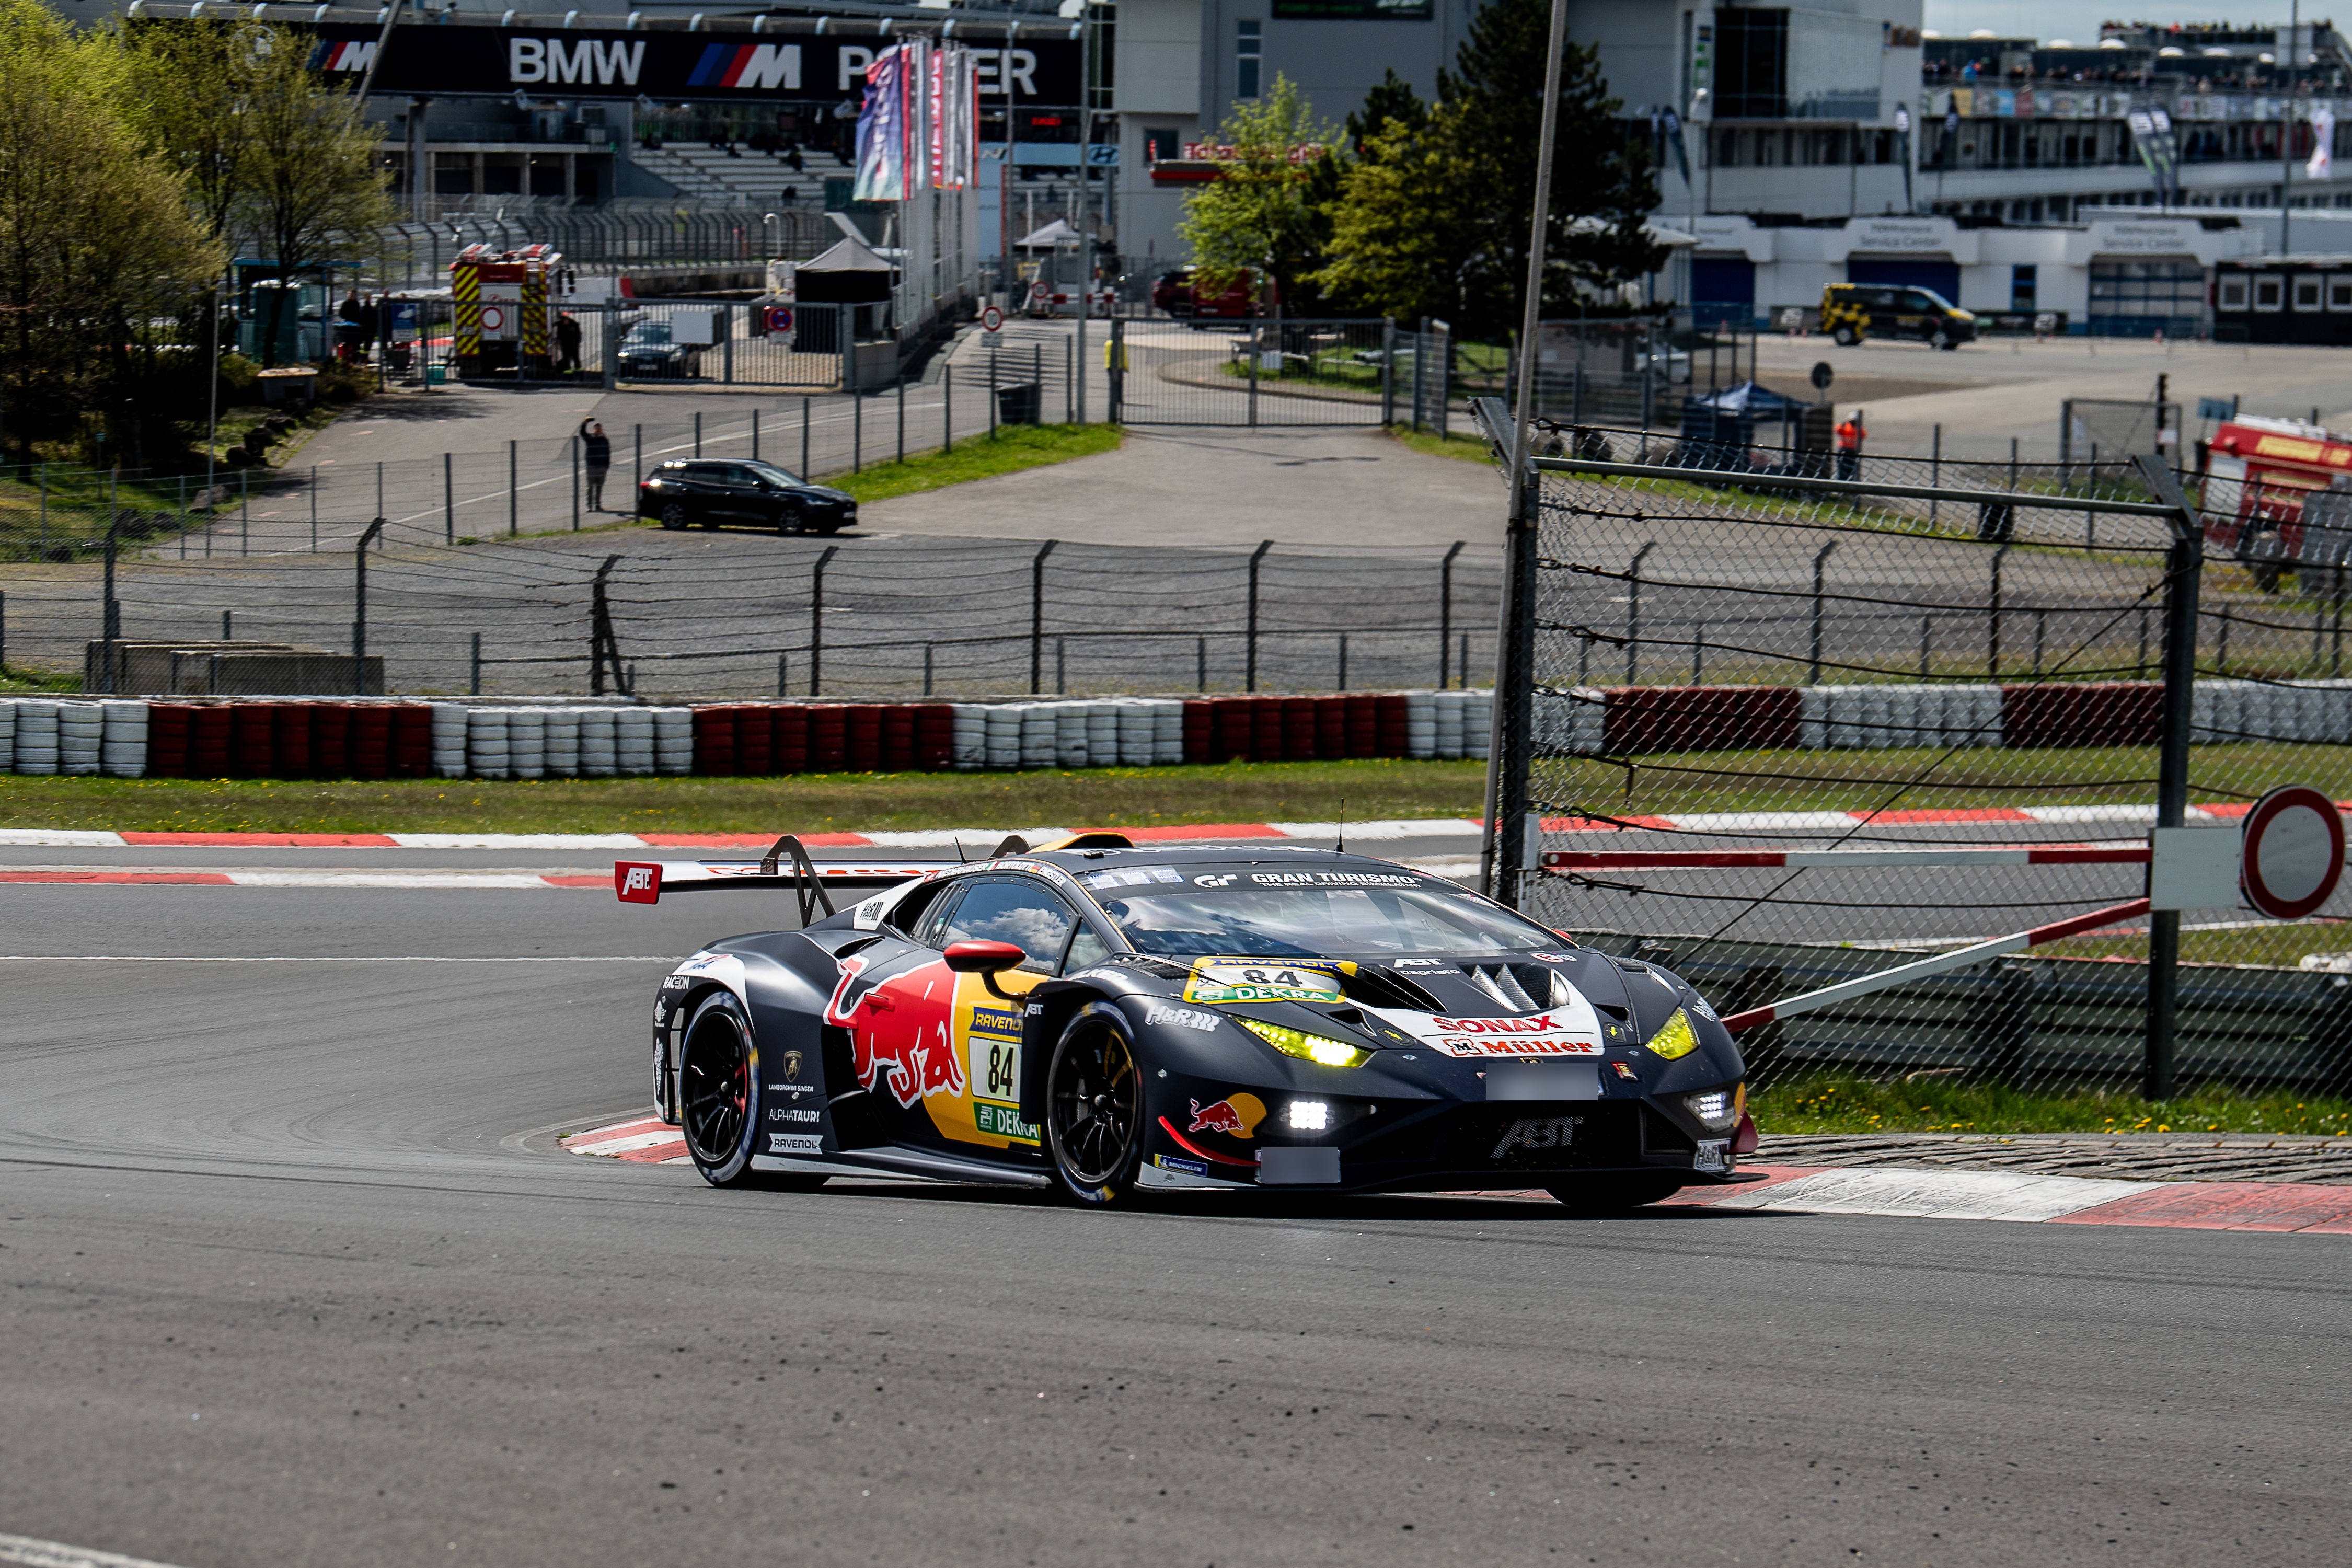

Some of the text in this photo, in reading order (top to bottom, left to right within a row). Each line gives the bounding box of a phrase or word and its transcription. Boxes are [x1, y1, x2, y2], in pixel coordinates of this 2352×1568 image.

[510, 38, 646, 86] BMW
[838, 45, 1037, 95] PER
[622, 867, 653, 895] ABT
[1251, 873, 1415, 884] GRAN TURISMO
[1219, 959, 1333, 969] RAVENOL
[1393, 958, 1444, 969] ABT
[1243, 969, 1303, 987] 84
[1235, 986, 1330, 1001] DEKRA
[1024, 1004, 1044, 1017] ABT
[975, 1013, 1023, 1031] RAVENO
[1433, 1015, 1565, 1033] SONAX
[1479, 1040, 1593, 1054] Müller
[988, 1044, 1014, 1097] 84
[769, 1108, 820, 1123] ALPHATAURI
[774, 1138, 818, 1149] RAVENOL
[1490, 1116, 1585, 1159] ABT
[1169, 1161, 1203, 1172] MICHELIN
